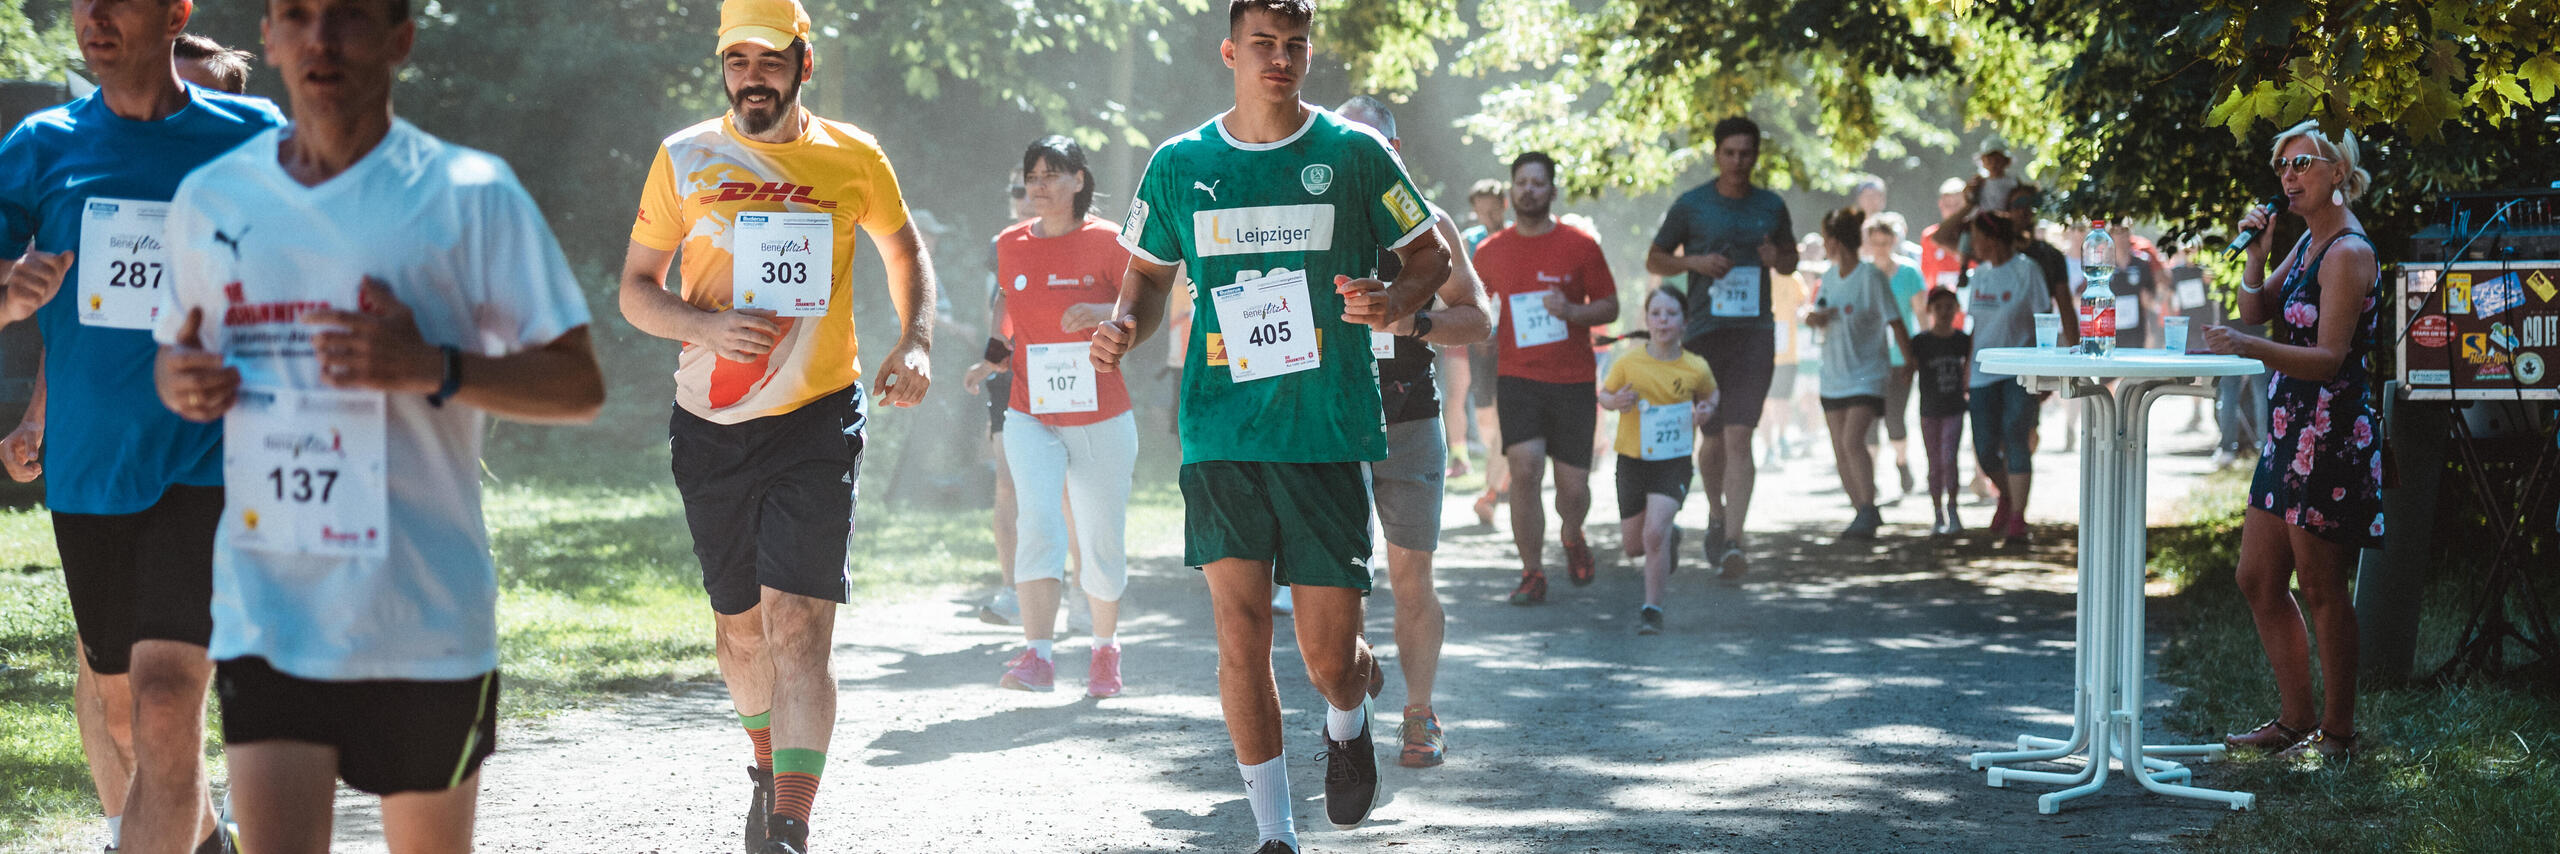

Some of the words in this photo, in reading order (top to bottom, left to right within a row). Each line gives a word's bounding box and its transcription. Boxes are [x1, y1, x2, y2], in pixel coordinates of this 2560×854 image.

[717, 182, 820, 206] DHL
[1127, 200, 1143, 231] IFTEC
[1236, 226, 1311, 246] Leipziger
[109, 260, 162, 288] 287
[761, 262, 807, 284] 303
[1249, 320, 1292, 347] 405
[2544, 315, 2558, 347] IT
[1047, 375, 1076, 391] 107
[1655, 428, 1681, 443] 273
[268, 467, 338, 502] 137
